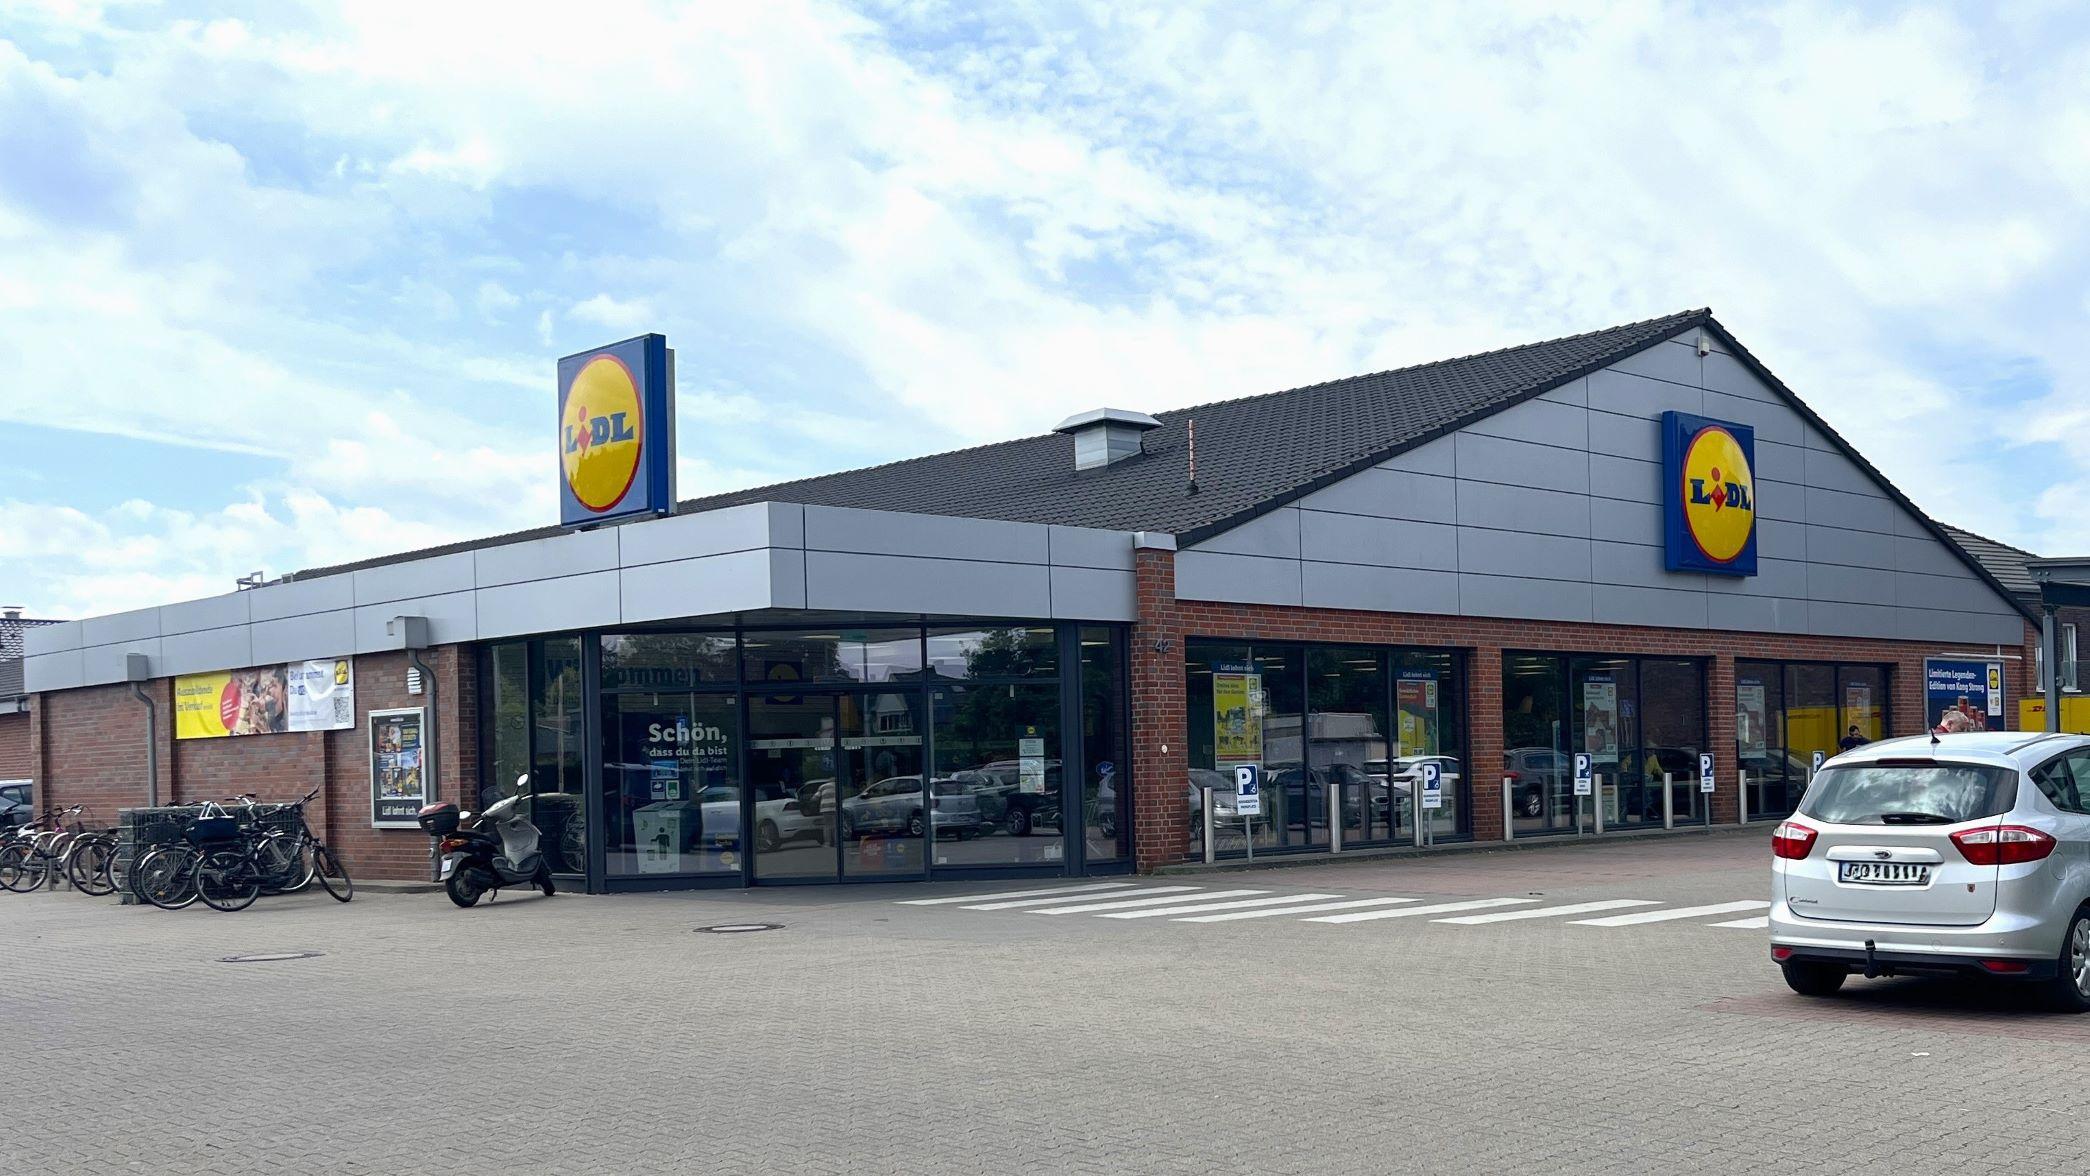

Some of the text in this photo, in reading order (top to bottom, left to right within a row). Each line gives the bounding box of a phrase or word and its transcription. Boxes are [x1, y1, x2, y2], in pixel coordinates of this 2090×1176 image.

[565, 406, 634, 458] LIDL
[1689, 467, 1751, 512] LIDL
[1155, 639, 1169, 653] 42
[1928, 668, 1977, 681] Limitierte Legenden-
[1929, 681, 1946, 690] Edition
[1947, 683, 1956, 691] von
[1969, 683, 1985, 694] Strong
[648, 722, 728, 744] Schön,
[649, 745, 728, 757] dass du da bist
[1576, 755, 1587, 777] P
[1701, 755, 1711, 776] P
[1813, 753, 1821, 772] P
[1237, 768, 1252, 795] P
[1423, 764, 1436, 789] P
